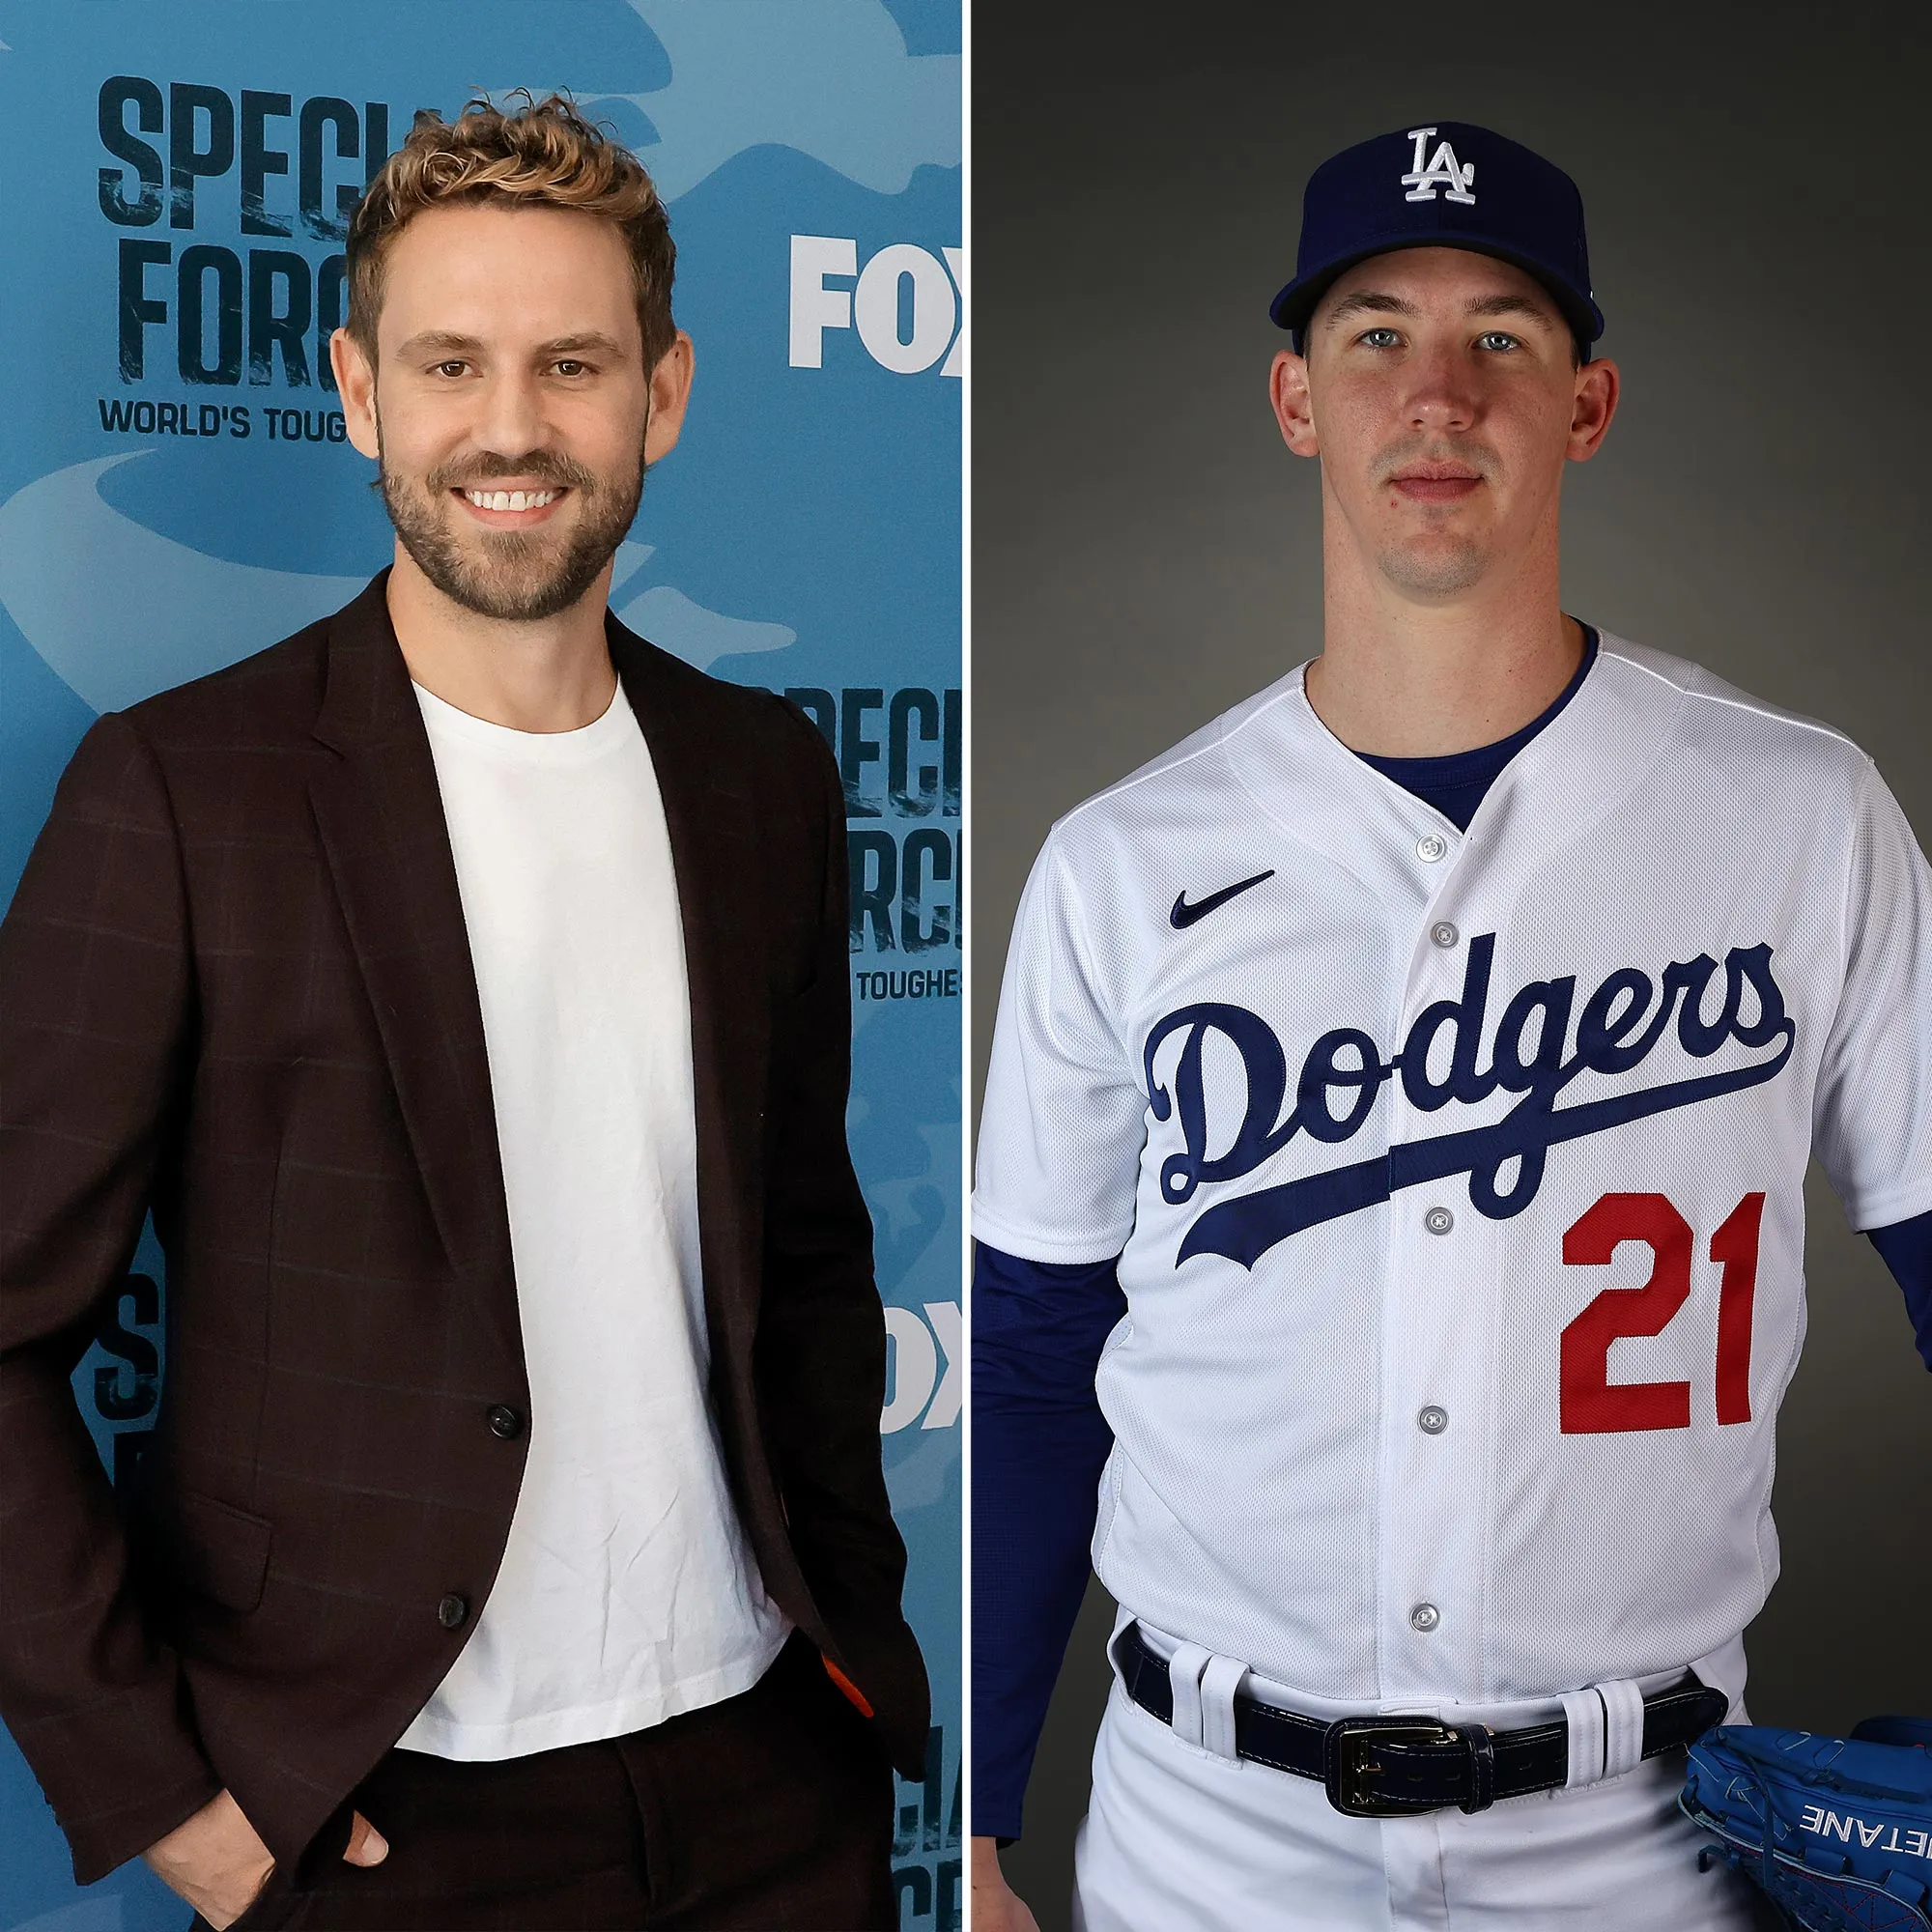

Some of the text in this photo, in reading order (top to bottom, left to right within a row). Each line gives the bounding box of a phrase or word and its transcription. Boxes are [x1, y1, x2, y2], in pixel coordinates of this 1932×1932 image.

[99, 75, 388, 242] SPECI
[1402, 127, 1476, 205] LA
[789, 234, 962, 378] FO
[99, 399, 348, 443] WORLD'S TOUG
[856, 969, 962, 1000] TOUGHE
[1144, 931, 1796, 1221] Dodgers
[1560, 1192, 1766, 1435] 21
[1799, 1804, 1932, 1860] ETANE
